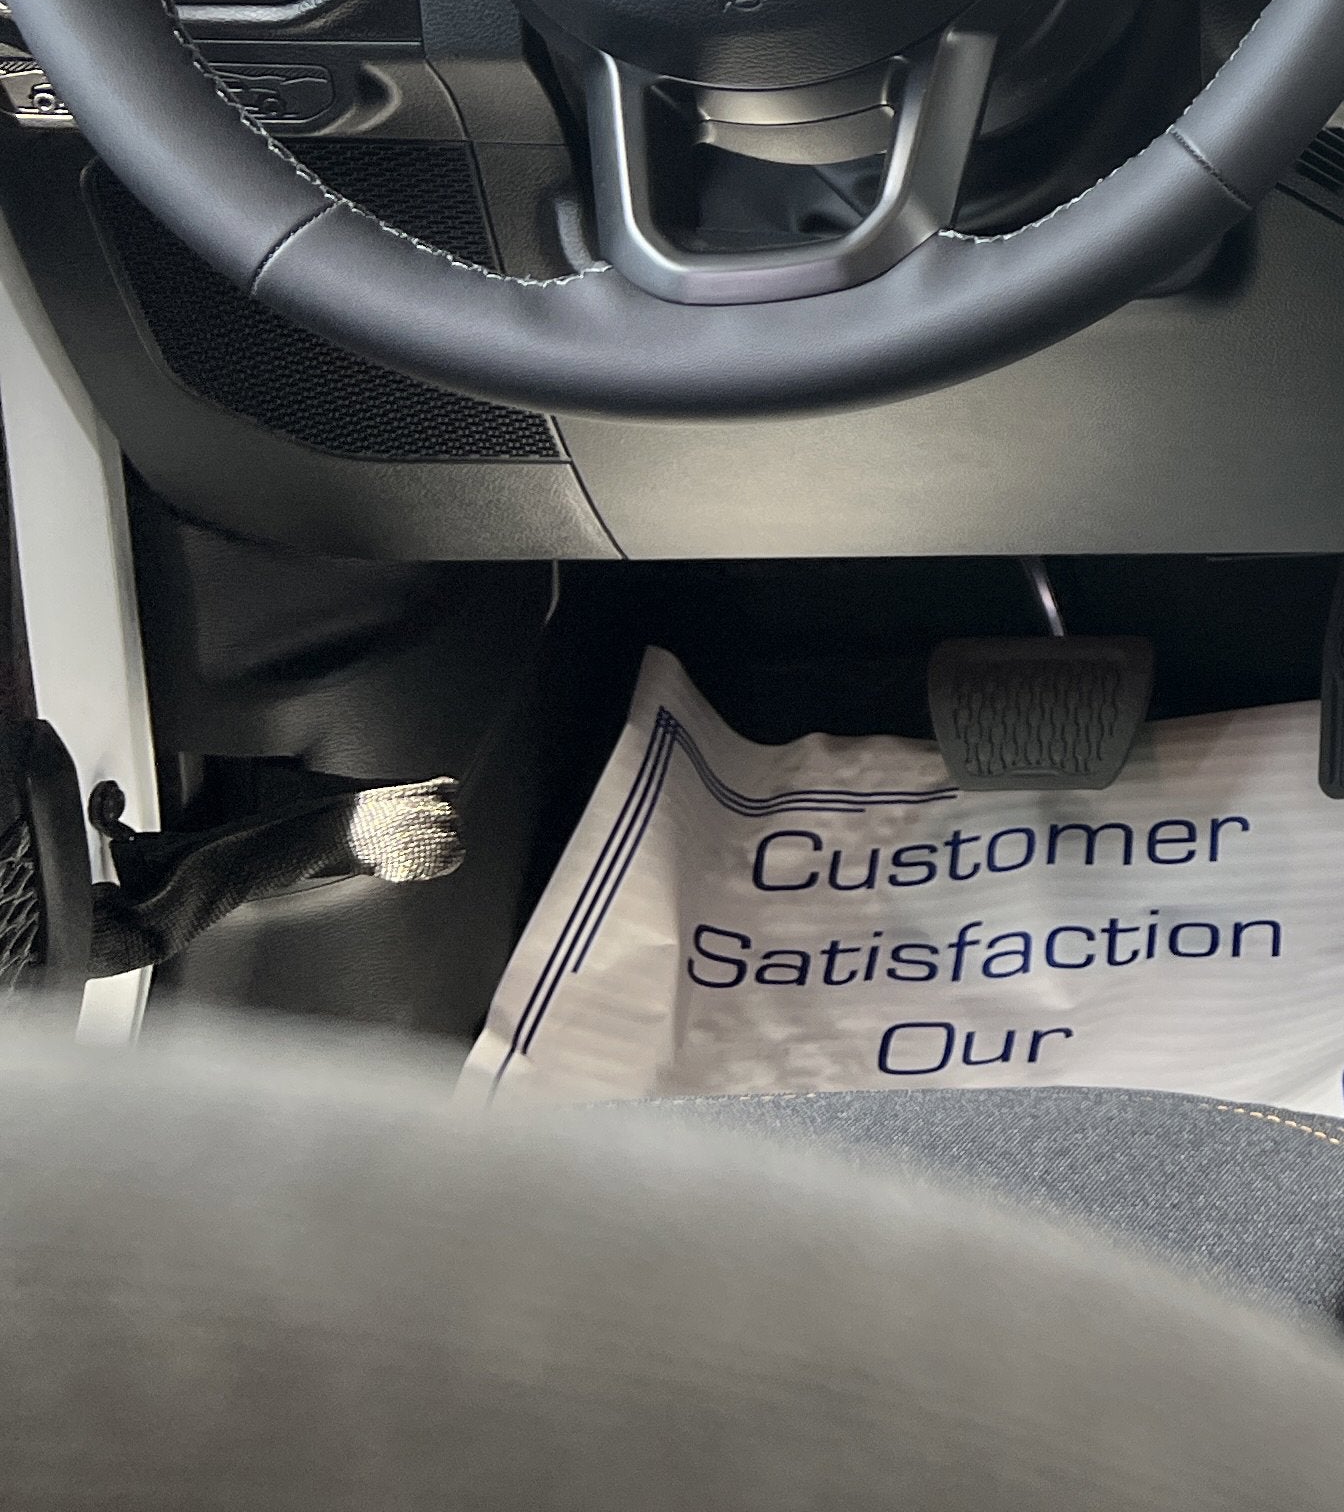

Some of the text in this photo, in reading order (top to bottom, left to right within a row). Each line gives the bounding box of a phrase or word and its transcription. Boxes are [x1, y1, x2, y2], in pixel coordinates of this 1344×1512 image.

[749, 815, 1251, 894] Customer
[686, 908, 1284, 988] Satisfaction
[877, 1019, 1073, 1076] Our
